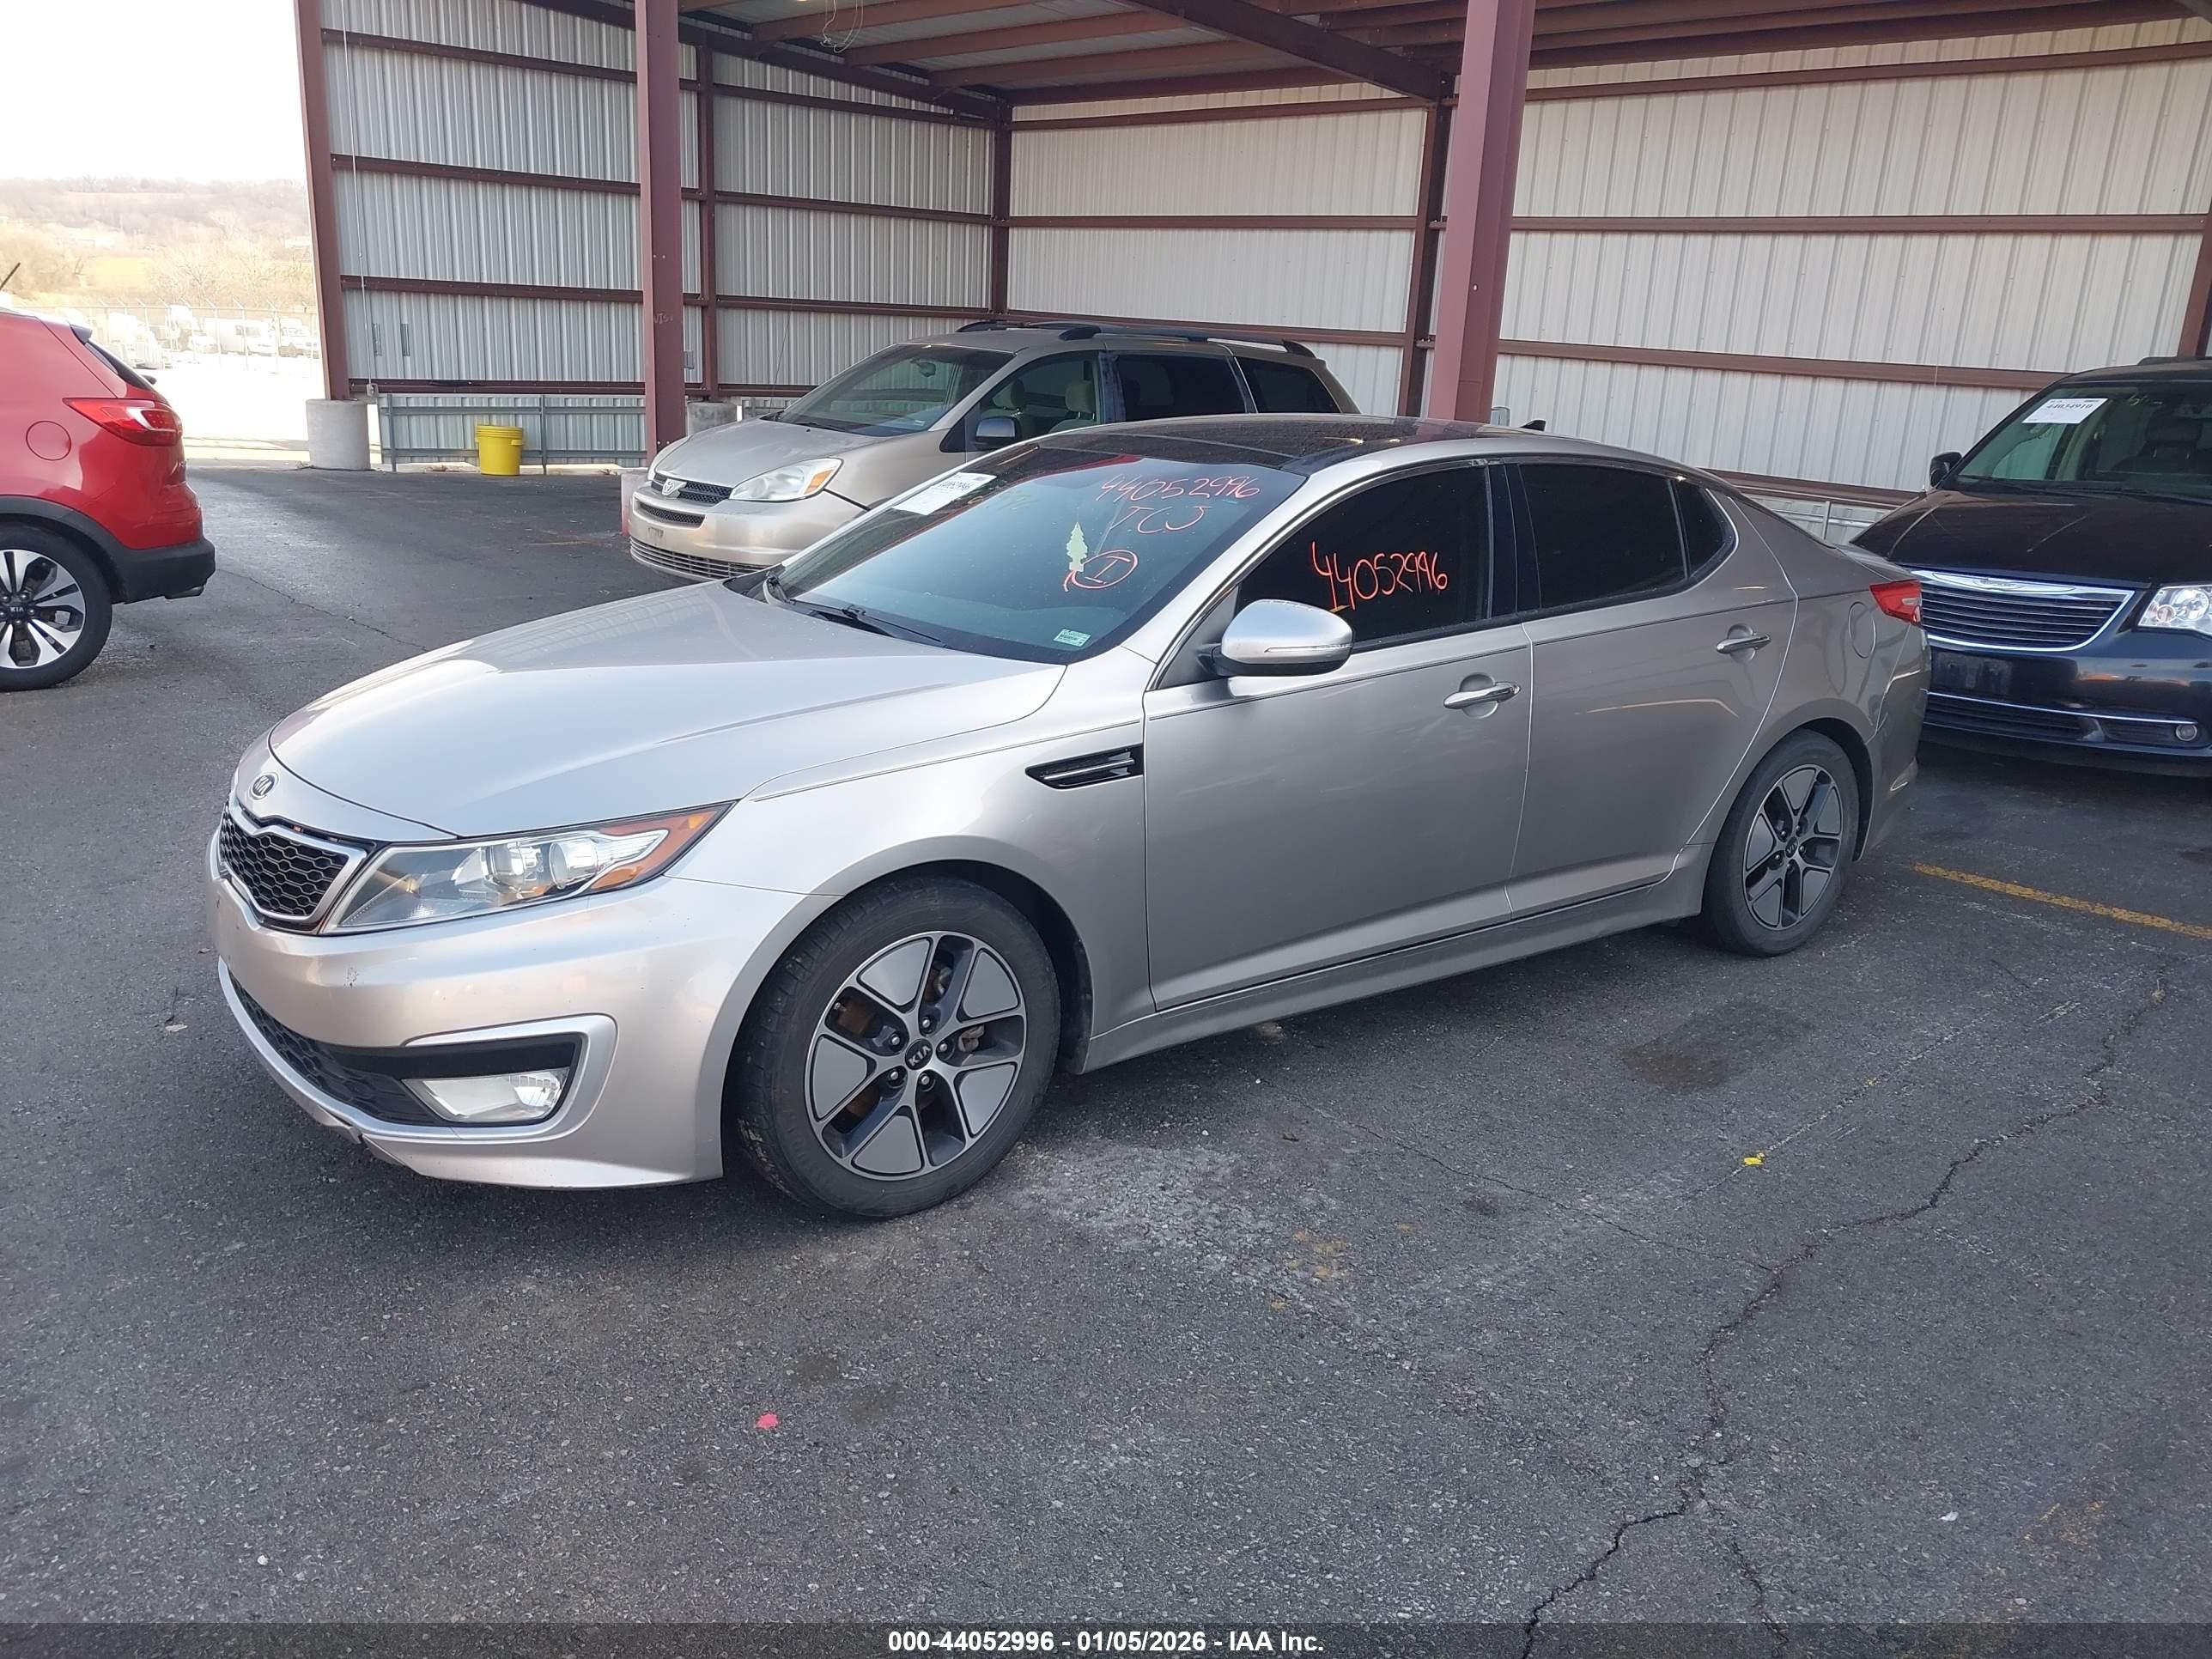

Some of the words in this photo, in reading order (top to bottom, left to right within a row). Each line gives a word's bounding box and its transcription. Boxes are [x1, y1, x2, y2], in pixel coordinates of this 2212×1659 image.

[1096, 474, 1261, 501] 44052996
[1311, 541, 1449, 611] 44052996
[908, 1045, 932, 1066] KIA
